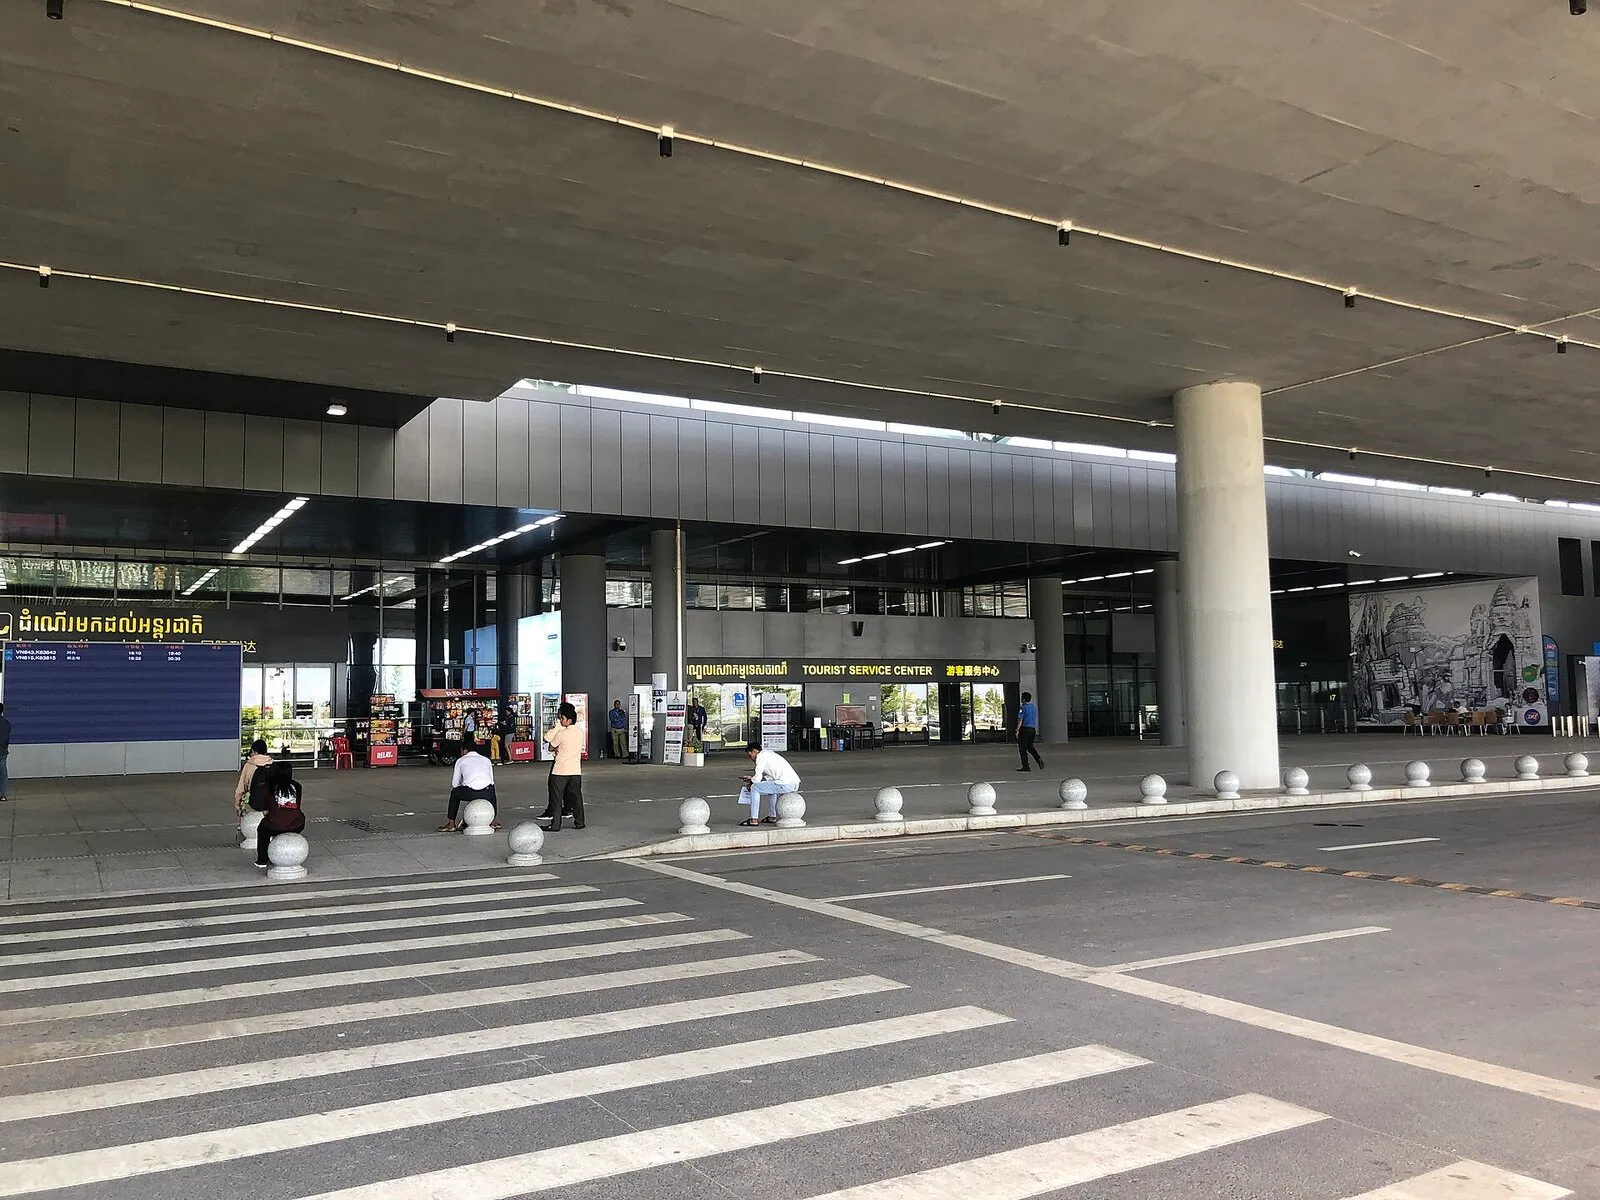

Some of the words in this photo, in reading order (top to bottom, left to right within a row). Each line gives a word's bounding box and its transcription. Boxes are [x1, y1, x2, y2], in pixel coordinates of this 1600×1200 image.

[802, 665, 847, 675] TOURIST
[849, 665, 892, 676] SERVICE
[894, 666, 933, 676] CENTER
[946, 665, 1000, 677] 游客服务中心
